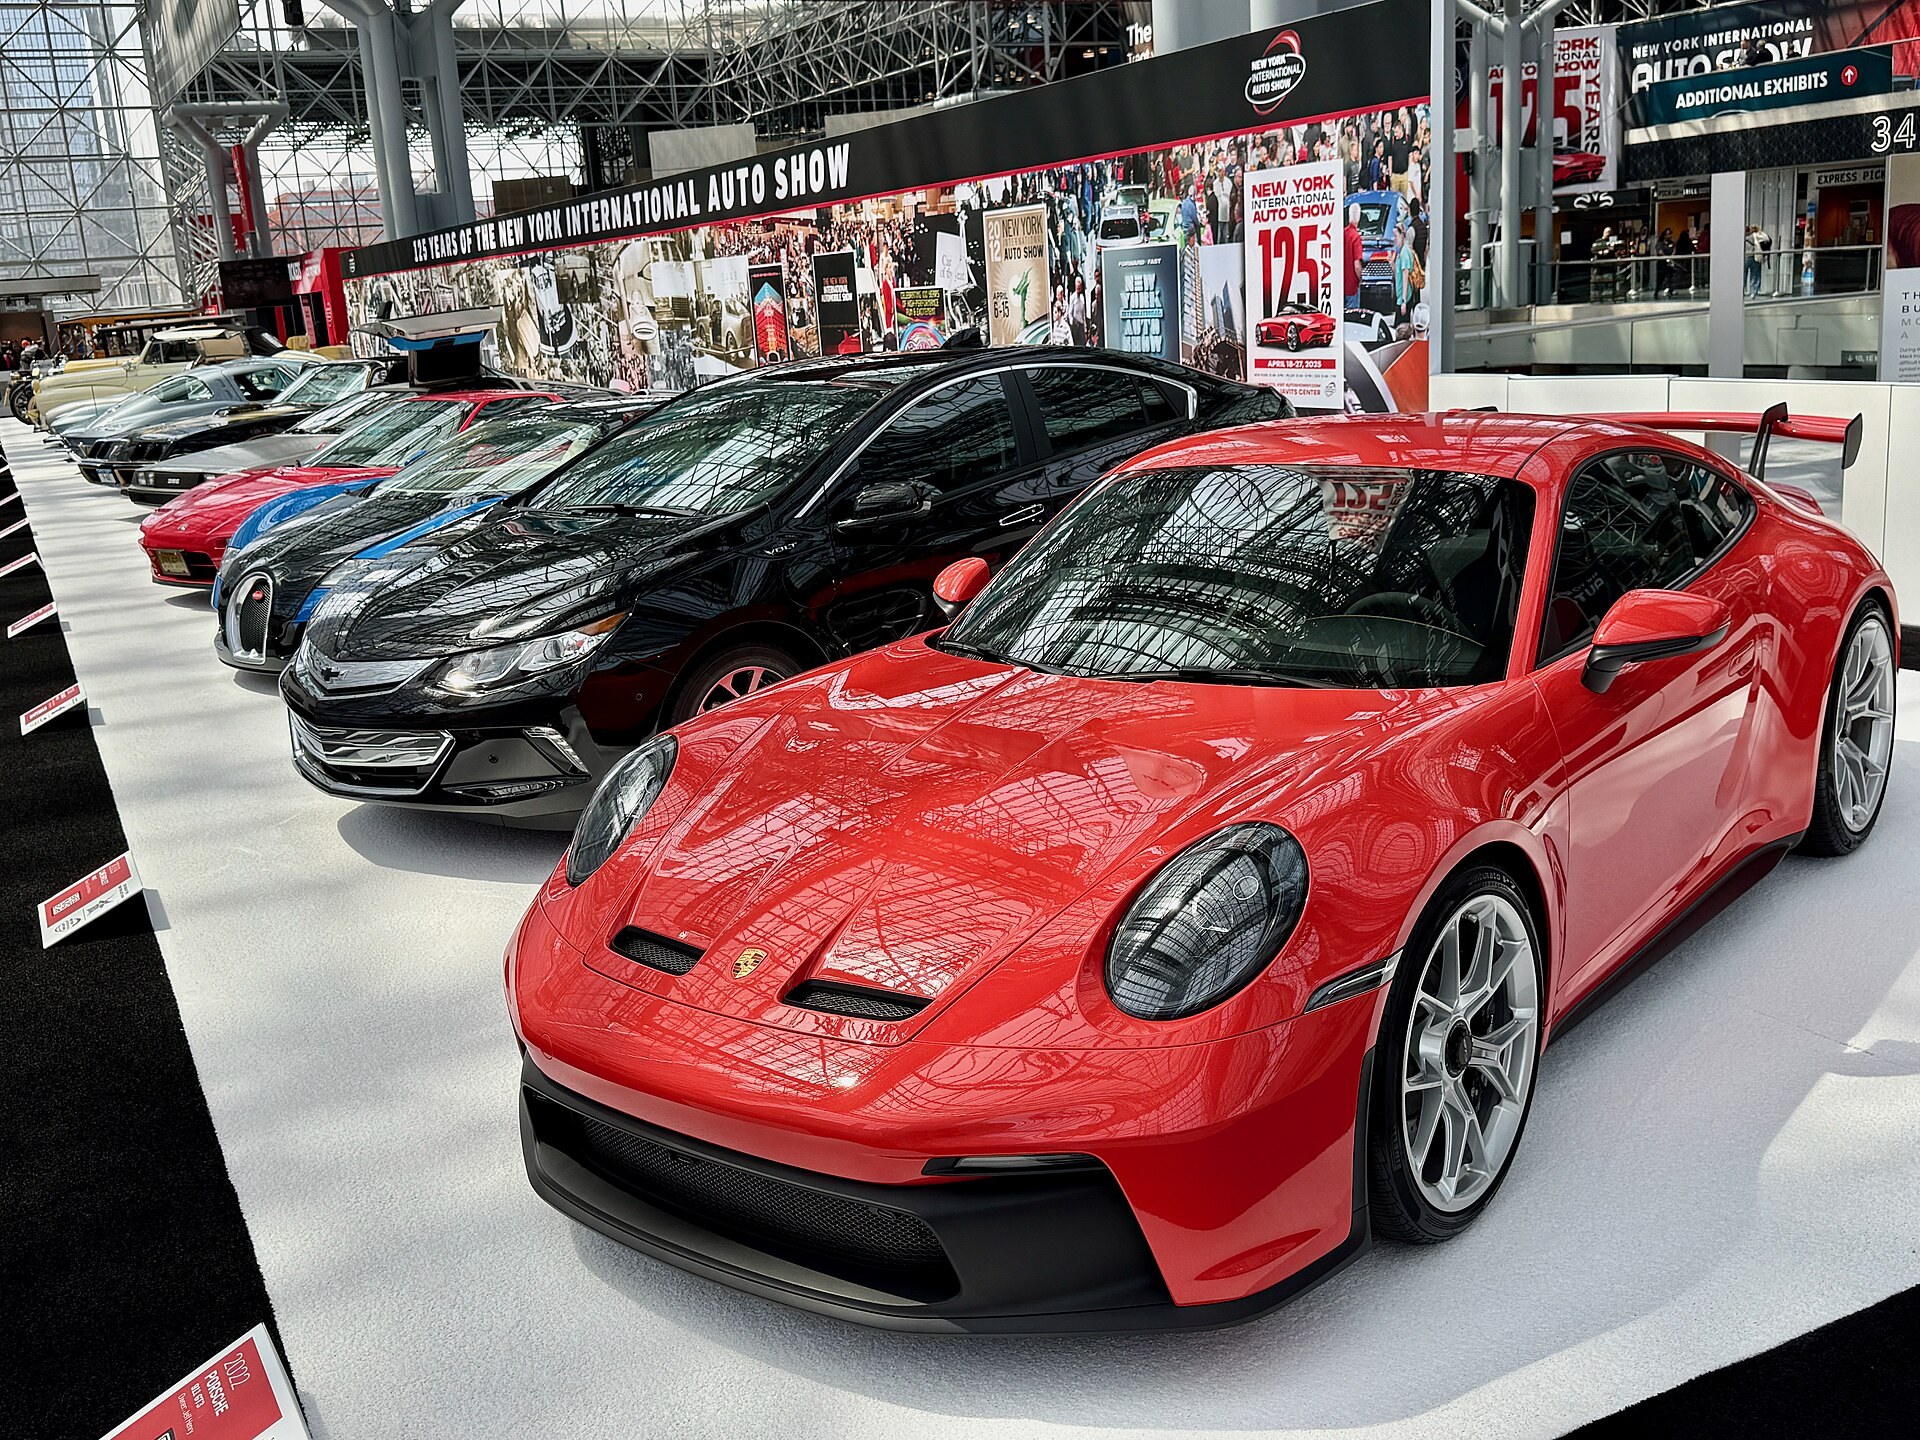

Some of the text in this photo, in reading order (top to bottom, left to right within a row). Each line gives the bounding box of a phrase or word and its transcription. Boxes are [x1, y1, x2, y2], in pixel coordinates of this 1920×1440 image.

[1126, 22, 1152, 47] The
[1632, 17, 1813, 59] NEW YORK INTERNATIONAL
[1557, 37, 1599, 52] ORK
[1251, 54, 1286, 71] NEW YORK
[1554, 58, 1600, 73] HOW
[1251, 63, 1301, 83] INTERNATIONAL
[1252, 77, 1291, 95] AUTO SHOW
[1676, 71, 1828, 109] ADDITIONAL EXHIBITS
[1586, 73, 1600, 155] YEARS
[1870, 112, 1917, 153] 34
[1252, 173, 1335, 199] NEW YORK
[1817, 171, 1857, 184] EXPRESS
[413, 142, 850, 262] 125 YEARS OF THE NEW YORK INTERNATIONAL AUTO SHOW
[1252, 191, 1335, 210] INTERNATIONAL
[1252, 202, 1335, 224] AUTO SHOW
[988, 221, 1000, 240] 20
[1002, 215, 1044, 238] NEW YORK
[1003, 234, 1043, 247] INTERNATIONAL
[989, 240, 1001, 262] 12
[1004, 245, 1044, 261] AUTO SHOW
[1118, 259, 1145, 267] FORWARD
[1258, 224, 1319, 318] 125
[1321, 222, 1332, 316] YEARS
[1124, 272, 1156, 291] NEW
[993, 292, 1008, 300] APRIL
[1120, 290, 1162, 309] YORK
[993, 301, 1010, 318] 6-15
[1125, 319, 1161, 336] AUTO
[1122, 335, 1163, 353] SHOW
[1267, 360, 1285, 368] APRIL
[1299, 388, 1321, 396] CENTER
[224, 1352, 251, 1390] 2022
[190, 1383, 206, 1409] 911 GT3
[204, 1370, 229, 1417] PORSCHE
